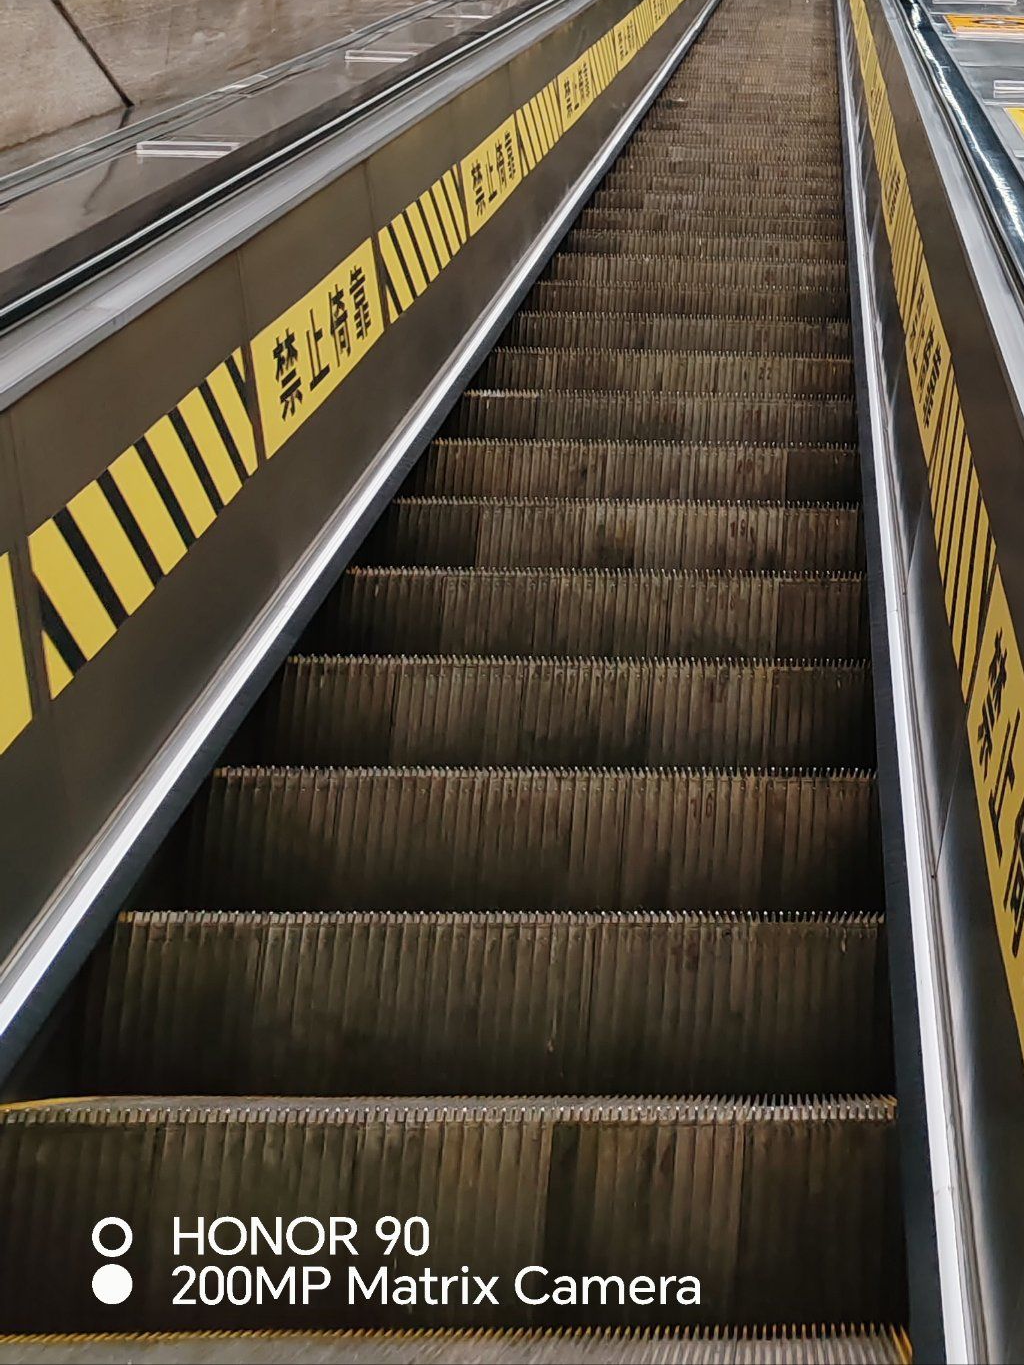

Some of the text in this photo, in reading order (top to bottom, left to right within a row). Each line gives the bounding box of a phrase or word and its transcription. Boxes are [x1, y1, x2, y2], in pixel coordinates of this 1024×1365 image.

[470, 130, 517, 218] 禁止倚靠
[272, 265, 372, 422] 禁止倚靠
